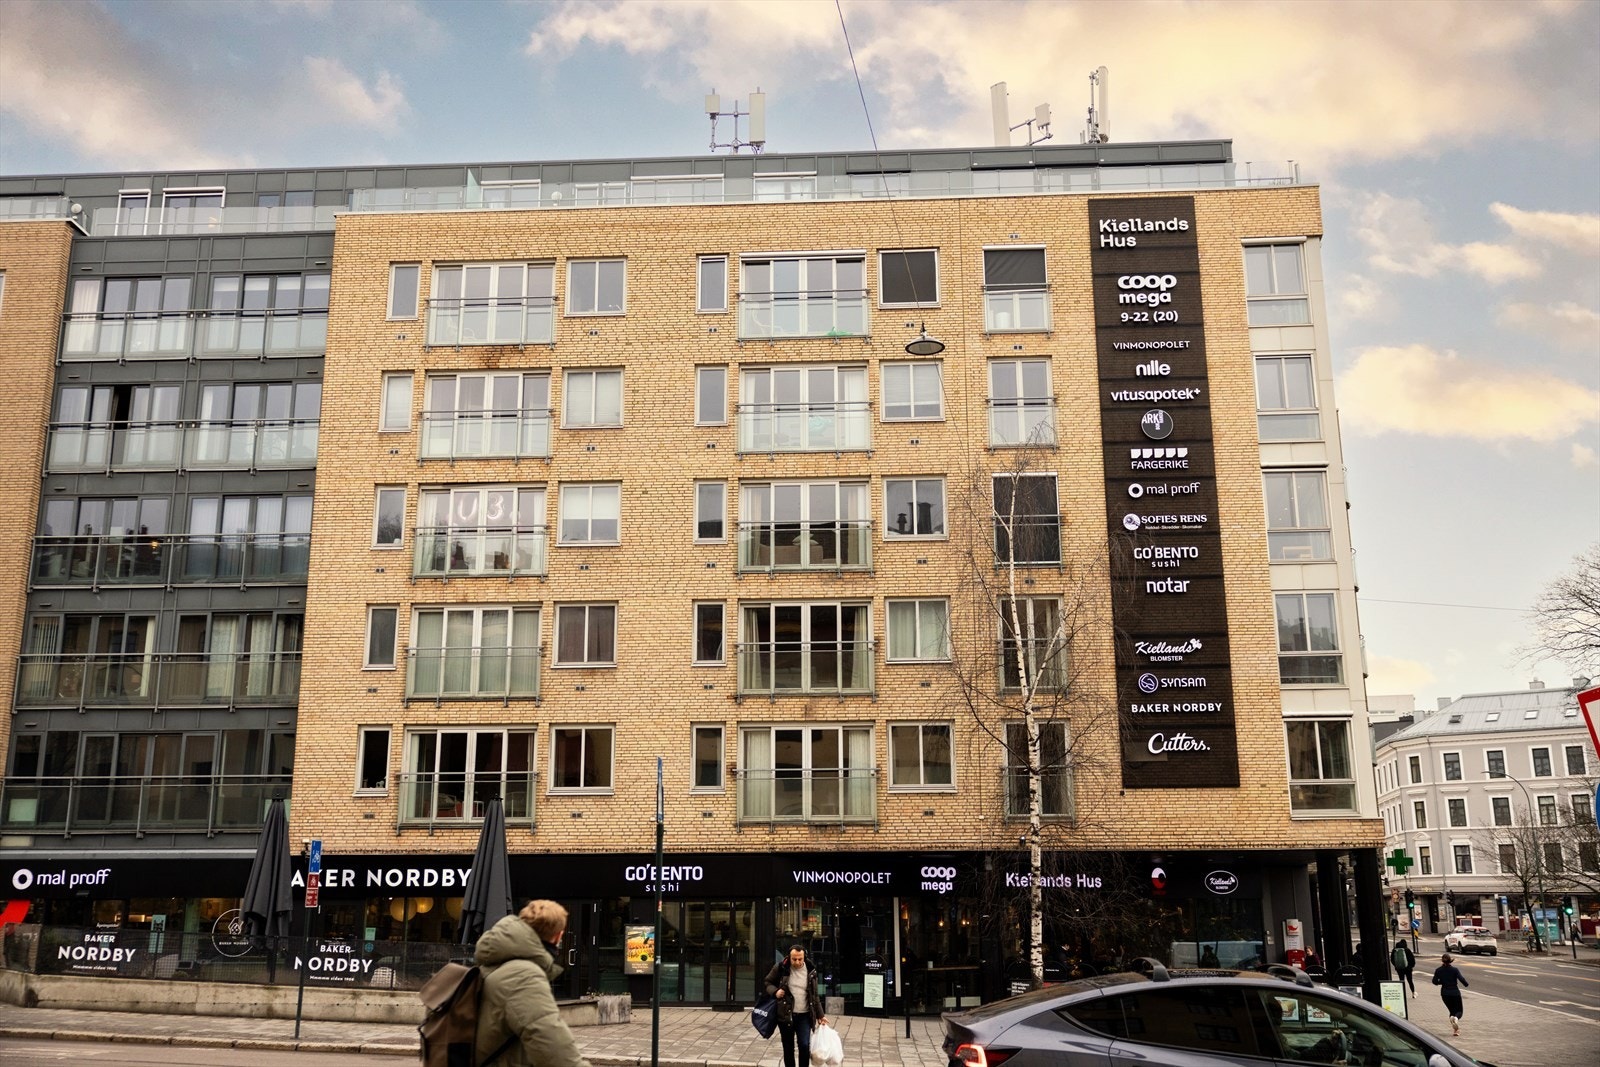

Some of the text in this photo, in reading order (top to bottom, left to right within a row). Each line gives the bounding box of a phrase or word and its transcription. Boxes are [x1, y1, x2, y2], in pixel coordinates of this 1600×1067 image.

[1099, 217, 1189, 233] Kiellands
[1100, 234, 1137, 248] Hus
[1117, 274, 1177, 291] coop
[1119, 292, 1172, 307] mega
[1120, 310, 1179, 323] 9-22 (20)
[1113, 340, 1191, 350] VINMONOPOLET
[1135, 360, 1171, 376] nille
[1142, 413, 1160, 424] ARK
[1131, 460, 1189, 470] FARGERIKE
[1146, 482, 1200, 496] mal proff
[1141, 514, 1208, 524] SOFIES RENS
[1133, 545, 1199, 559] GO'BENTO
[1151, 560, 1180, 568] sushi
[1146, 577, 1190, 593] notar
[1134, 641, 1195, 654] Kiellands
[1161, 677, 1207, 688] SYNSAM
[1131, 703, 1222, 713] BAKER NORDBY
[1148, 732, 1211, 754] Cutters.
[36, 868, 111, 889] mal proff
[366, 868, 472, 887] NORDBY
[793, 870, 892, 884] VINMONOPOLET
[920, 866, 957, 881] coop
[1076, 873, 1102, 888] Hus
[921, 880, 953, 894] mega
[84, 934, 116, 943] BAKER
[57, 945, 136, 963] NORDBY
[320, 944, 351, 953] BAKER
